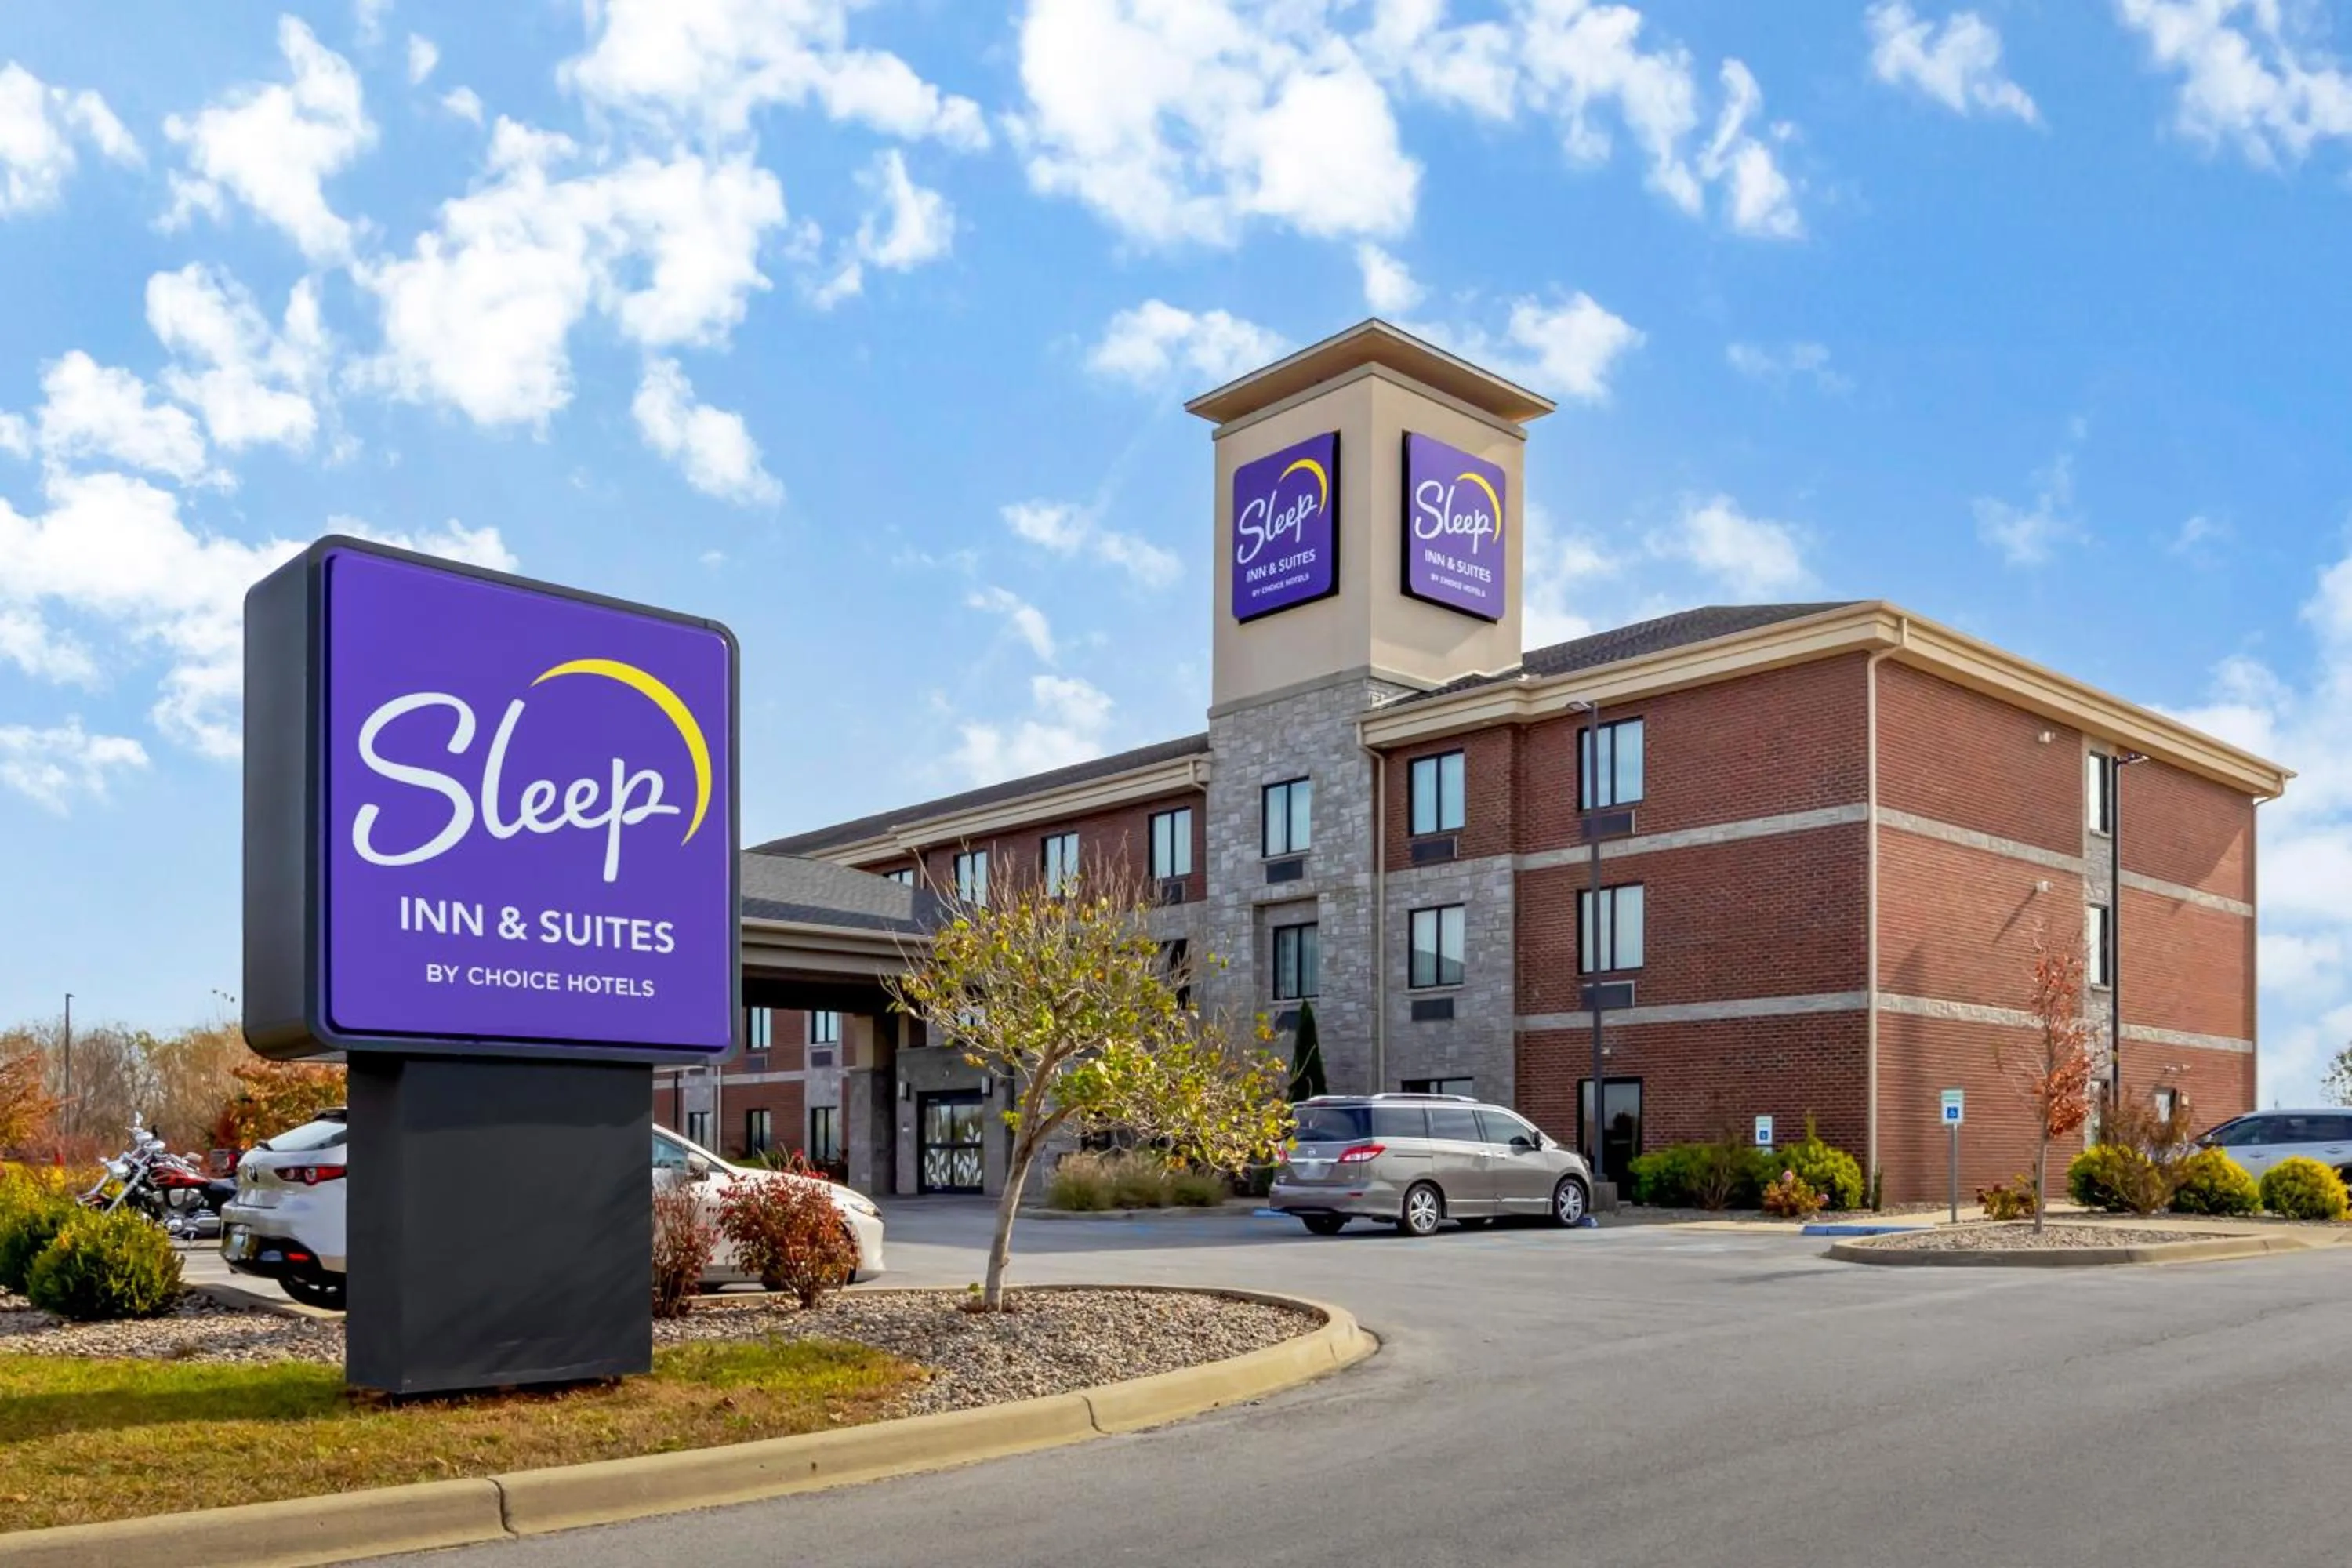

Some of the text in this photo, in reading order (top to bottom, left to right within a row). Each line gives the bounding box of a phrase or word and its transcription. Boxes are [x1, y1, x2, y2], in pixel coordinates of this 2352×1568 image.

[1237, 489, 1318, 564] Sleep
[1414, 480, 1493, 555] Sleep
[1246, 549, 1316, 583] INN & SUITES
[1425, 549, 1491, 583] INN & SUITES
[352, 691, 681, 883] Sleep
[401, 895, 675, 954] INN & SUITES
[426, 963, 655, 998] BY CHOICE HOTELS
